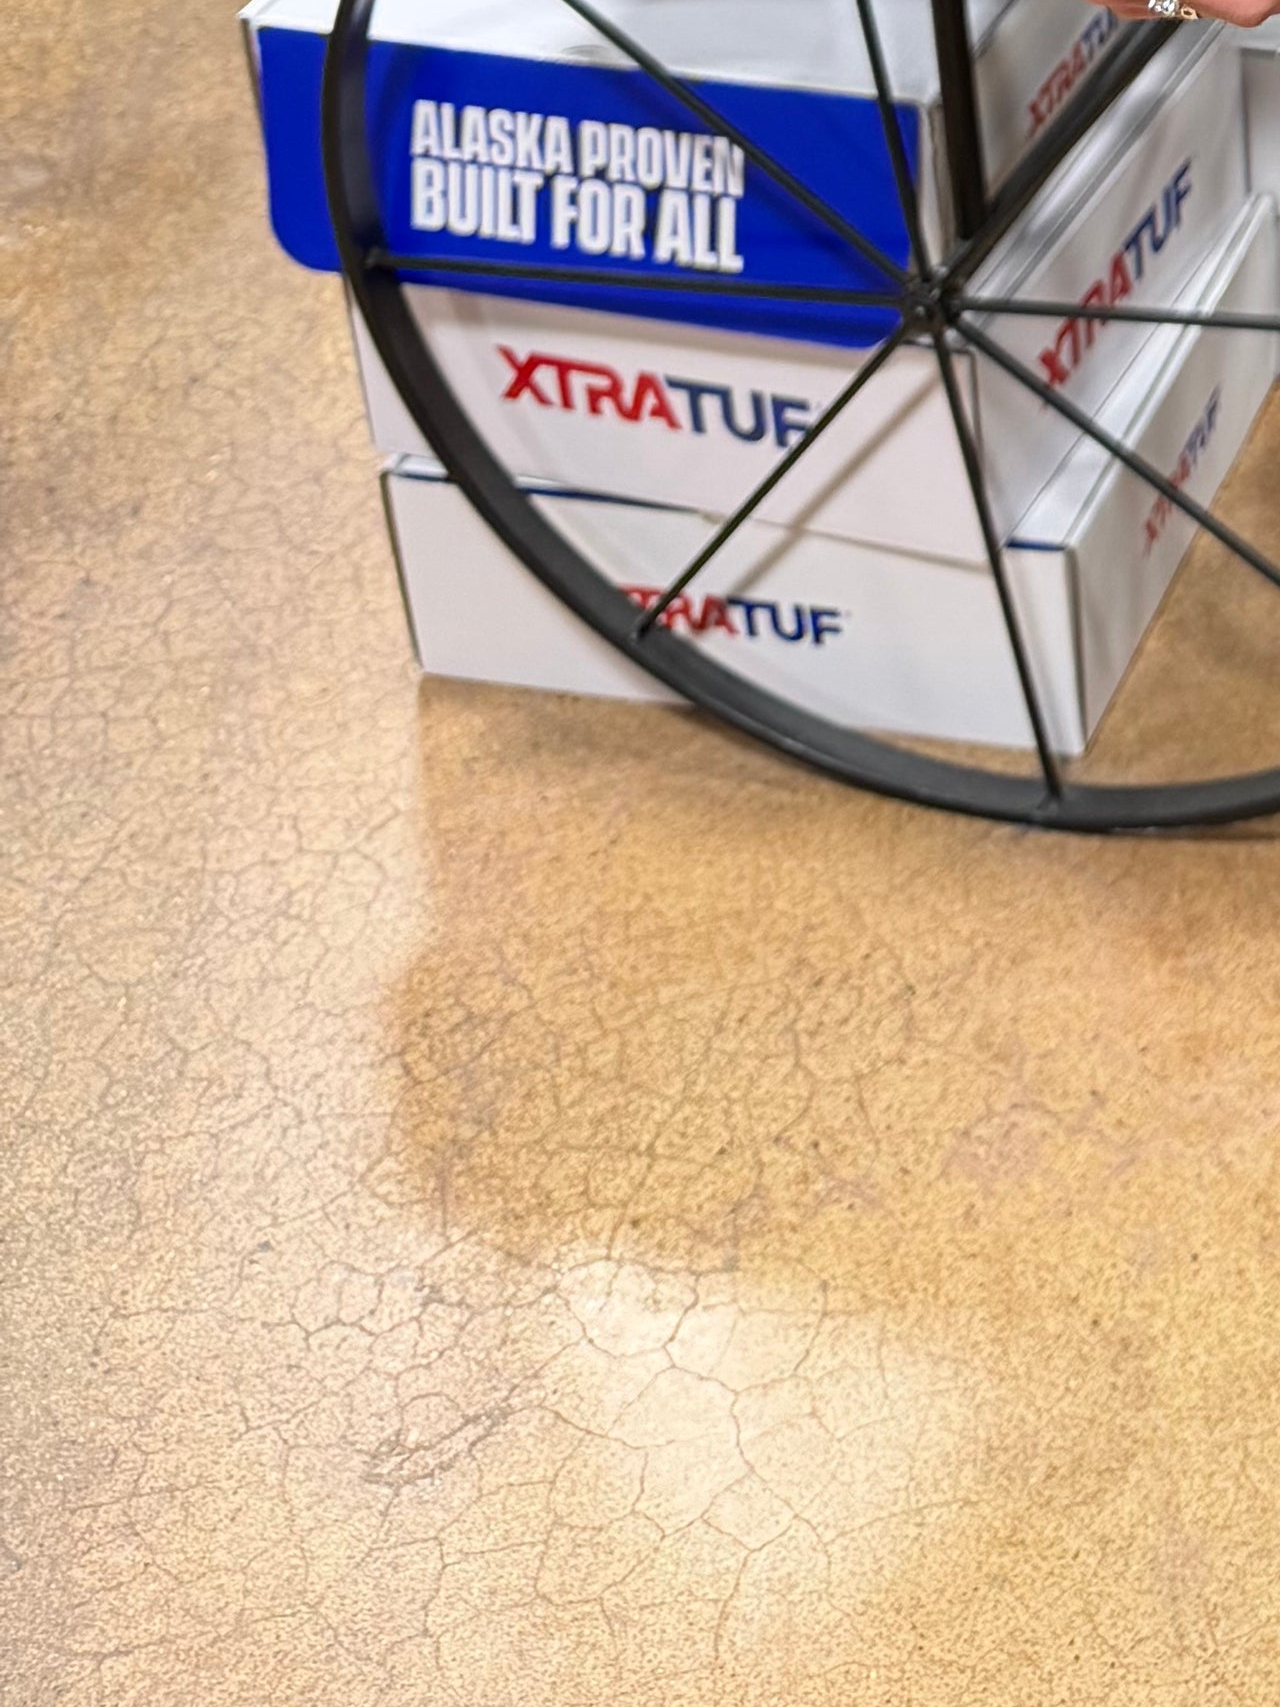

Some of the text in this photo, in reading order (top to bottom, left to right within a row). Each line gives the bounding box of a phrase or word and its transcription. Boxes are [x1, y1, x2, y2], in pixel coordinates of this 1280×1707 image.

[411, 98, 745, 198] ALASKA PROVEN
[410, 158, 745, 274] BUILT FOR ALL
[1036, 153, 1193, 412] XTRATUF
[496, 344, 818, 450] XTRATUF
[615, 585, 846, 646] TRATUF
